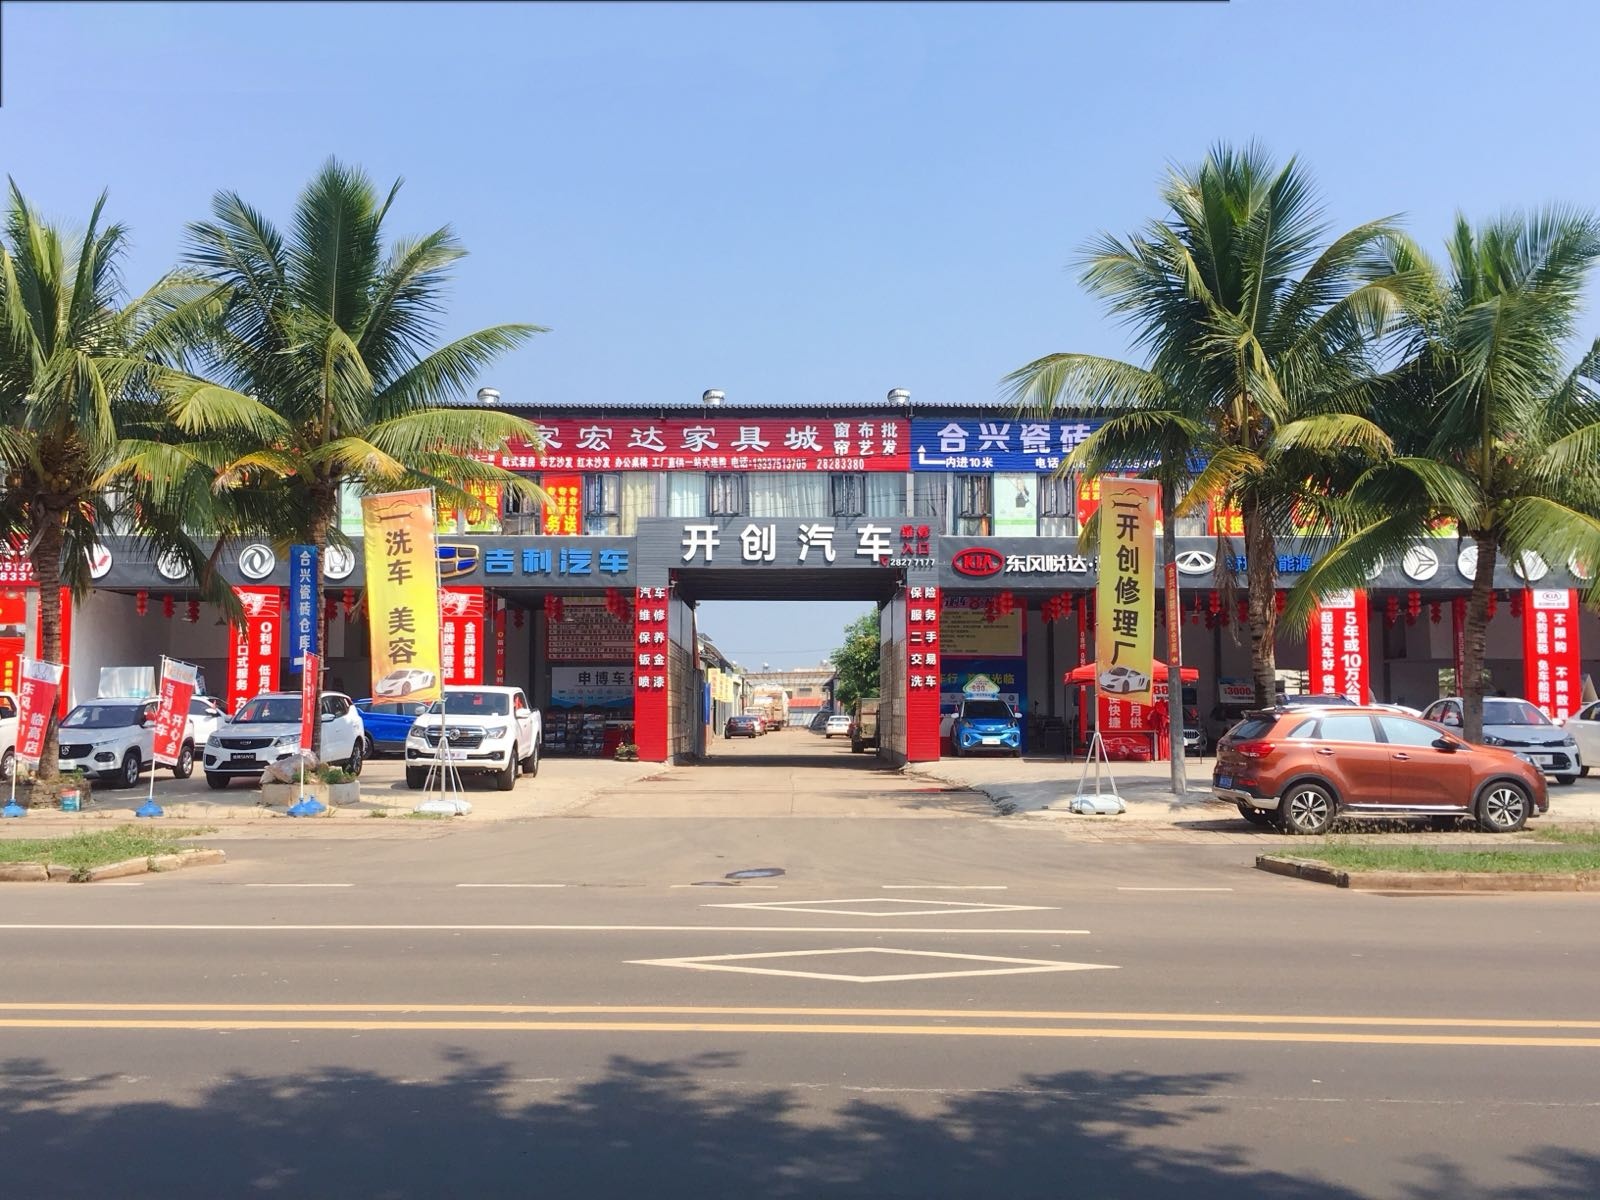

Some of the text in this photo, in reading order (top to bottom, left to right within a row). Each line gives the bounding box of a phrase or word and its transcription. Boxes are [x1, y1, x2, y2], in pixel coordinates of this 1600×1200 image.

[833, 422, 850, 456] 窗帘
[858, 422, 875, 456] 布艺
[881, 422, 898, 456] 批发
[937, 423, 1092, 453] 合兴瓷砖
[577, 456, 611, 469] 红木沙发
[816, 458, 865, 470] 28283380
[945, 457, 994, 468] 内进10米
[1035, 458, 1059, 469] 电话
[682, 523, 894, 562] 开创汽车
[901, 542, 930, 555] 入口
[485, 549, 629, 574] 吉利汽车
[890, 558, 936, 567] 28277177
[963, 556, 995, 570] KIA
[1005, 554, 1101, 574] 东风悦达·
[386, 528, 418, 665] 洗车 美容
[640, 587, 665, 599] 汽车
[910, 587, 936, 599] 保险
[1111, 513, 1141, 666] 开创修理厂
[299, 550, 312, 650] 合兴瓷砖仓库
[639, 609, 665, 622] 维修
[910, 609, 936, 622] 服务
[639, 632, 665, 644] 保养
[910, 631, 936, 644] 二手
[443, 622, 455, 678] 品牌直营店
[464, 622, 476, 678] 全品牌销售
[639, 654, 665, 666] 钣金
[910, 654, 936, 666] 交易
[639, 676, 665, 688] 喷漆
[910, 676, 936, 688] 洗车
[23, 711, 45, 754] 临高店
[165, 713, 184, 755] 开心会
